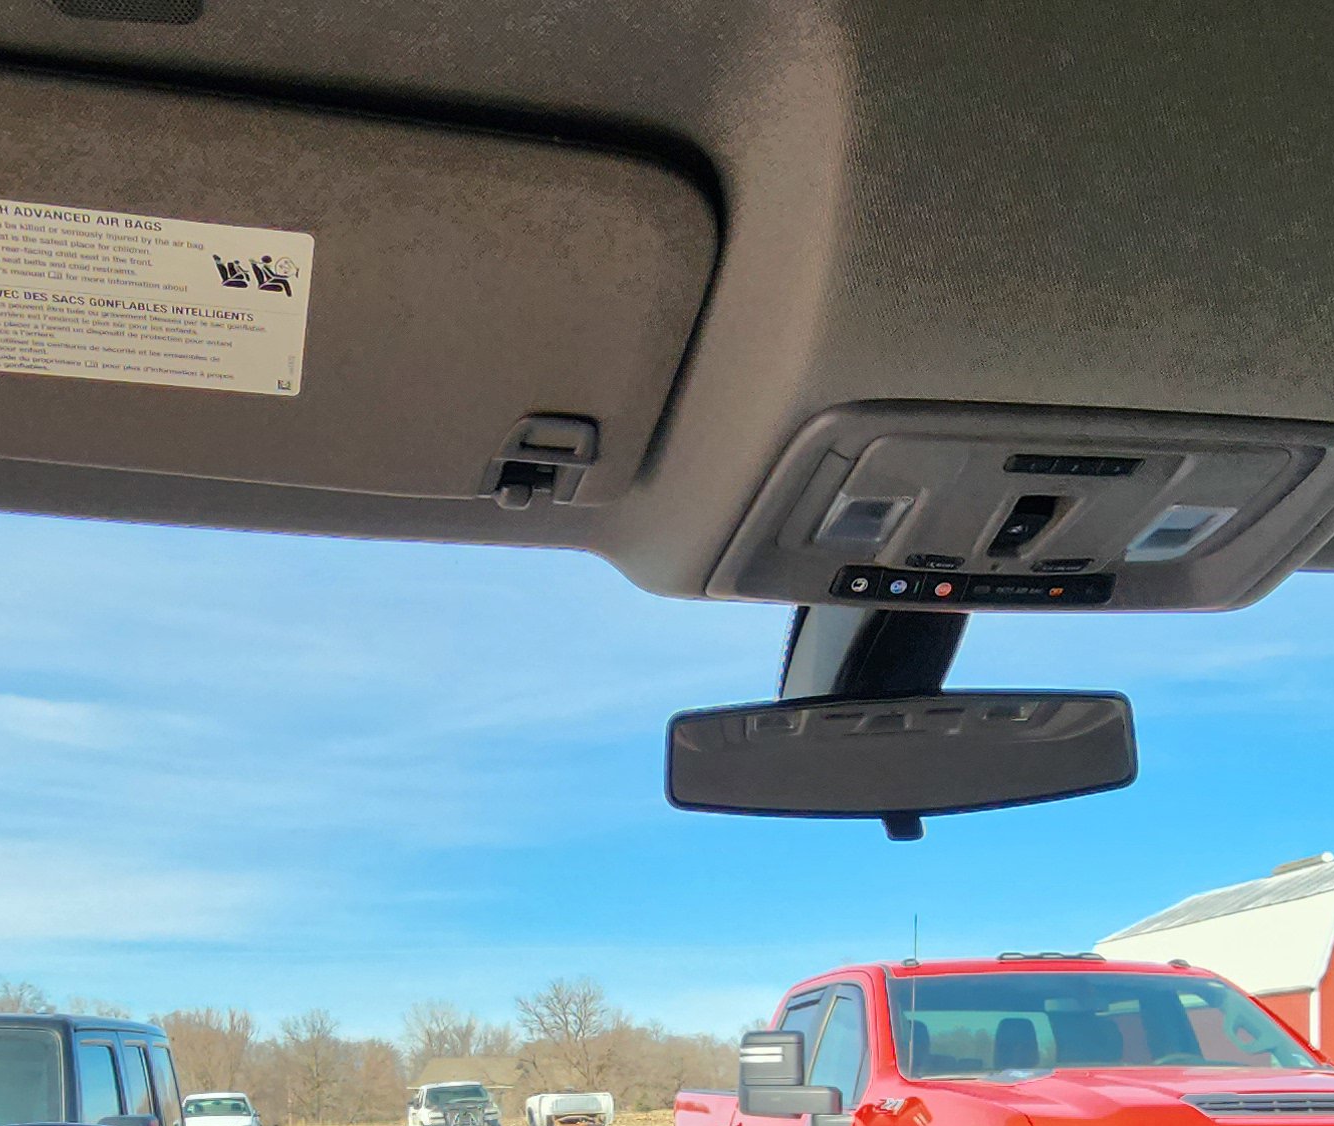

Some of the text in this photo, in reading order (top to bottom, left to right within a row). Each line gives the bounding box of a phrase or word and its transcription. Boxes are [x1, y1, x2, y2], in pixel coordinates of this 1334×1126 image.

[14, 206, 90, 224] ADVANCED
[97, 216, 119, 227] AIR
[125, 220, 162, 231] BAGS
[24, 291, 48, 301] DES
[52, 294, 85, 305] SACS
[89, 297, 168, 314] GONFLABLES
[171, 305, 254, 322] INTELLIGENTS
